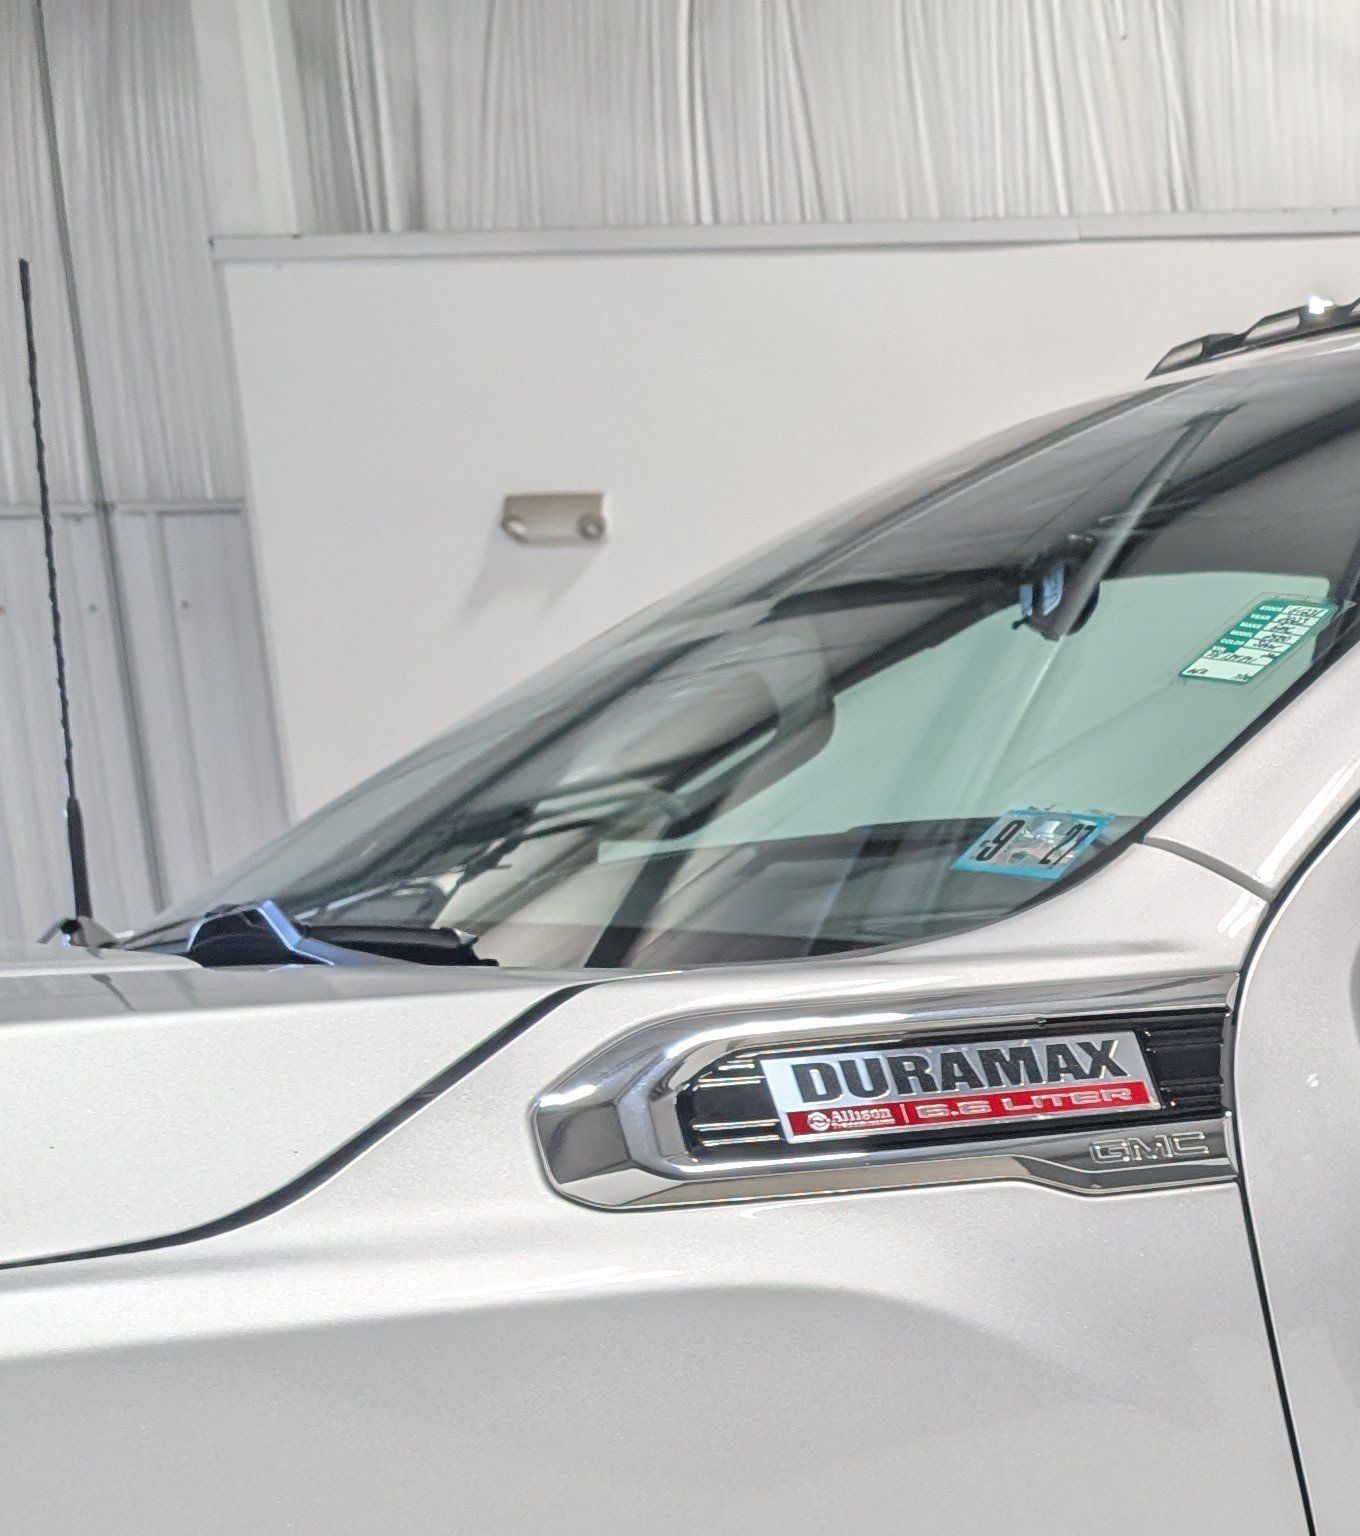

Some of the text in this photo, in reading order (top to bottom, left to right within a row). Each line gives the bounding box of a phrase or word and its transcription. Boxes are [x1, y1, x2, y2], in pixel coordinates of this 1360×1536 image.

[1039, 824, 1097, 869] 27
[790, 1039, 1131, 1104] DURAMAX
[831, 1087, 1133, 1122] Allison 6.6 LITER
[1089, 1130, 1210, 1166] GMC
